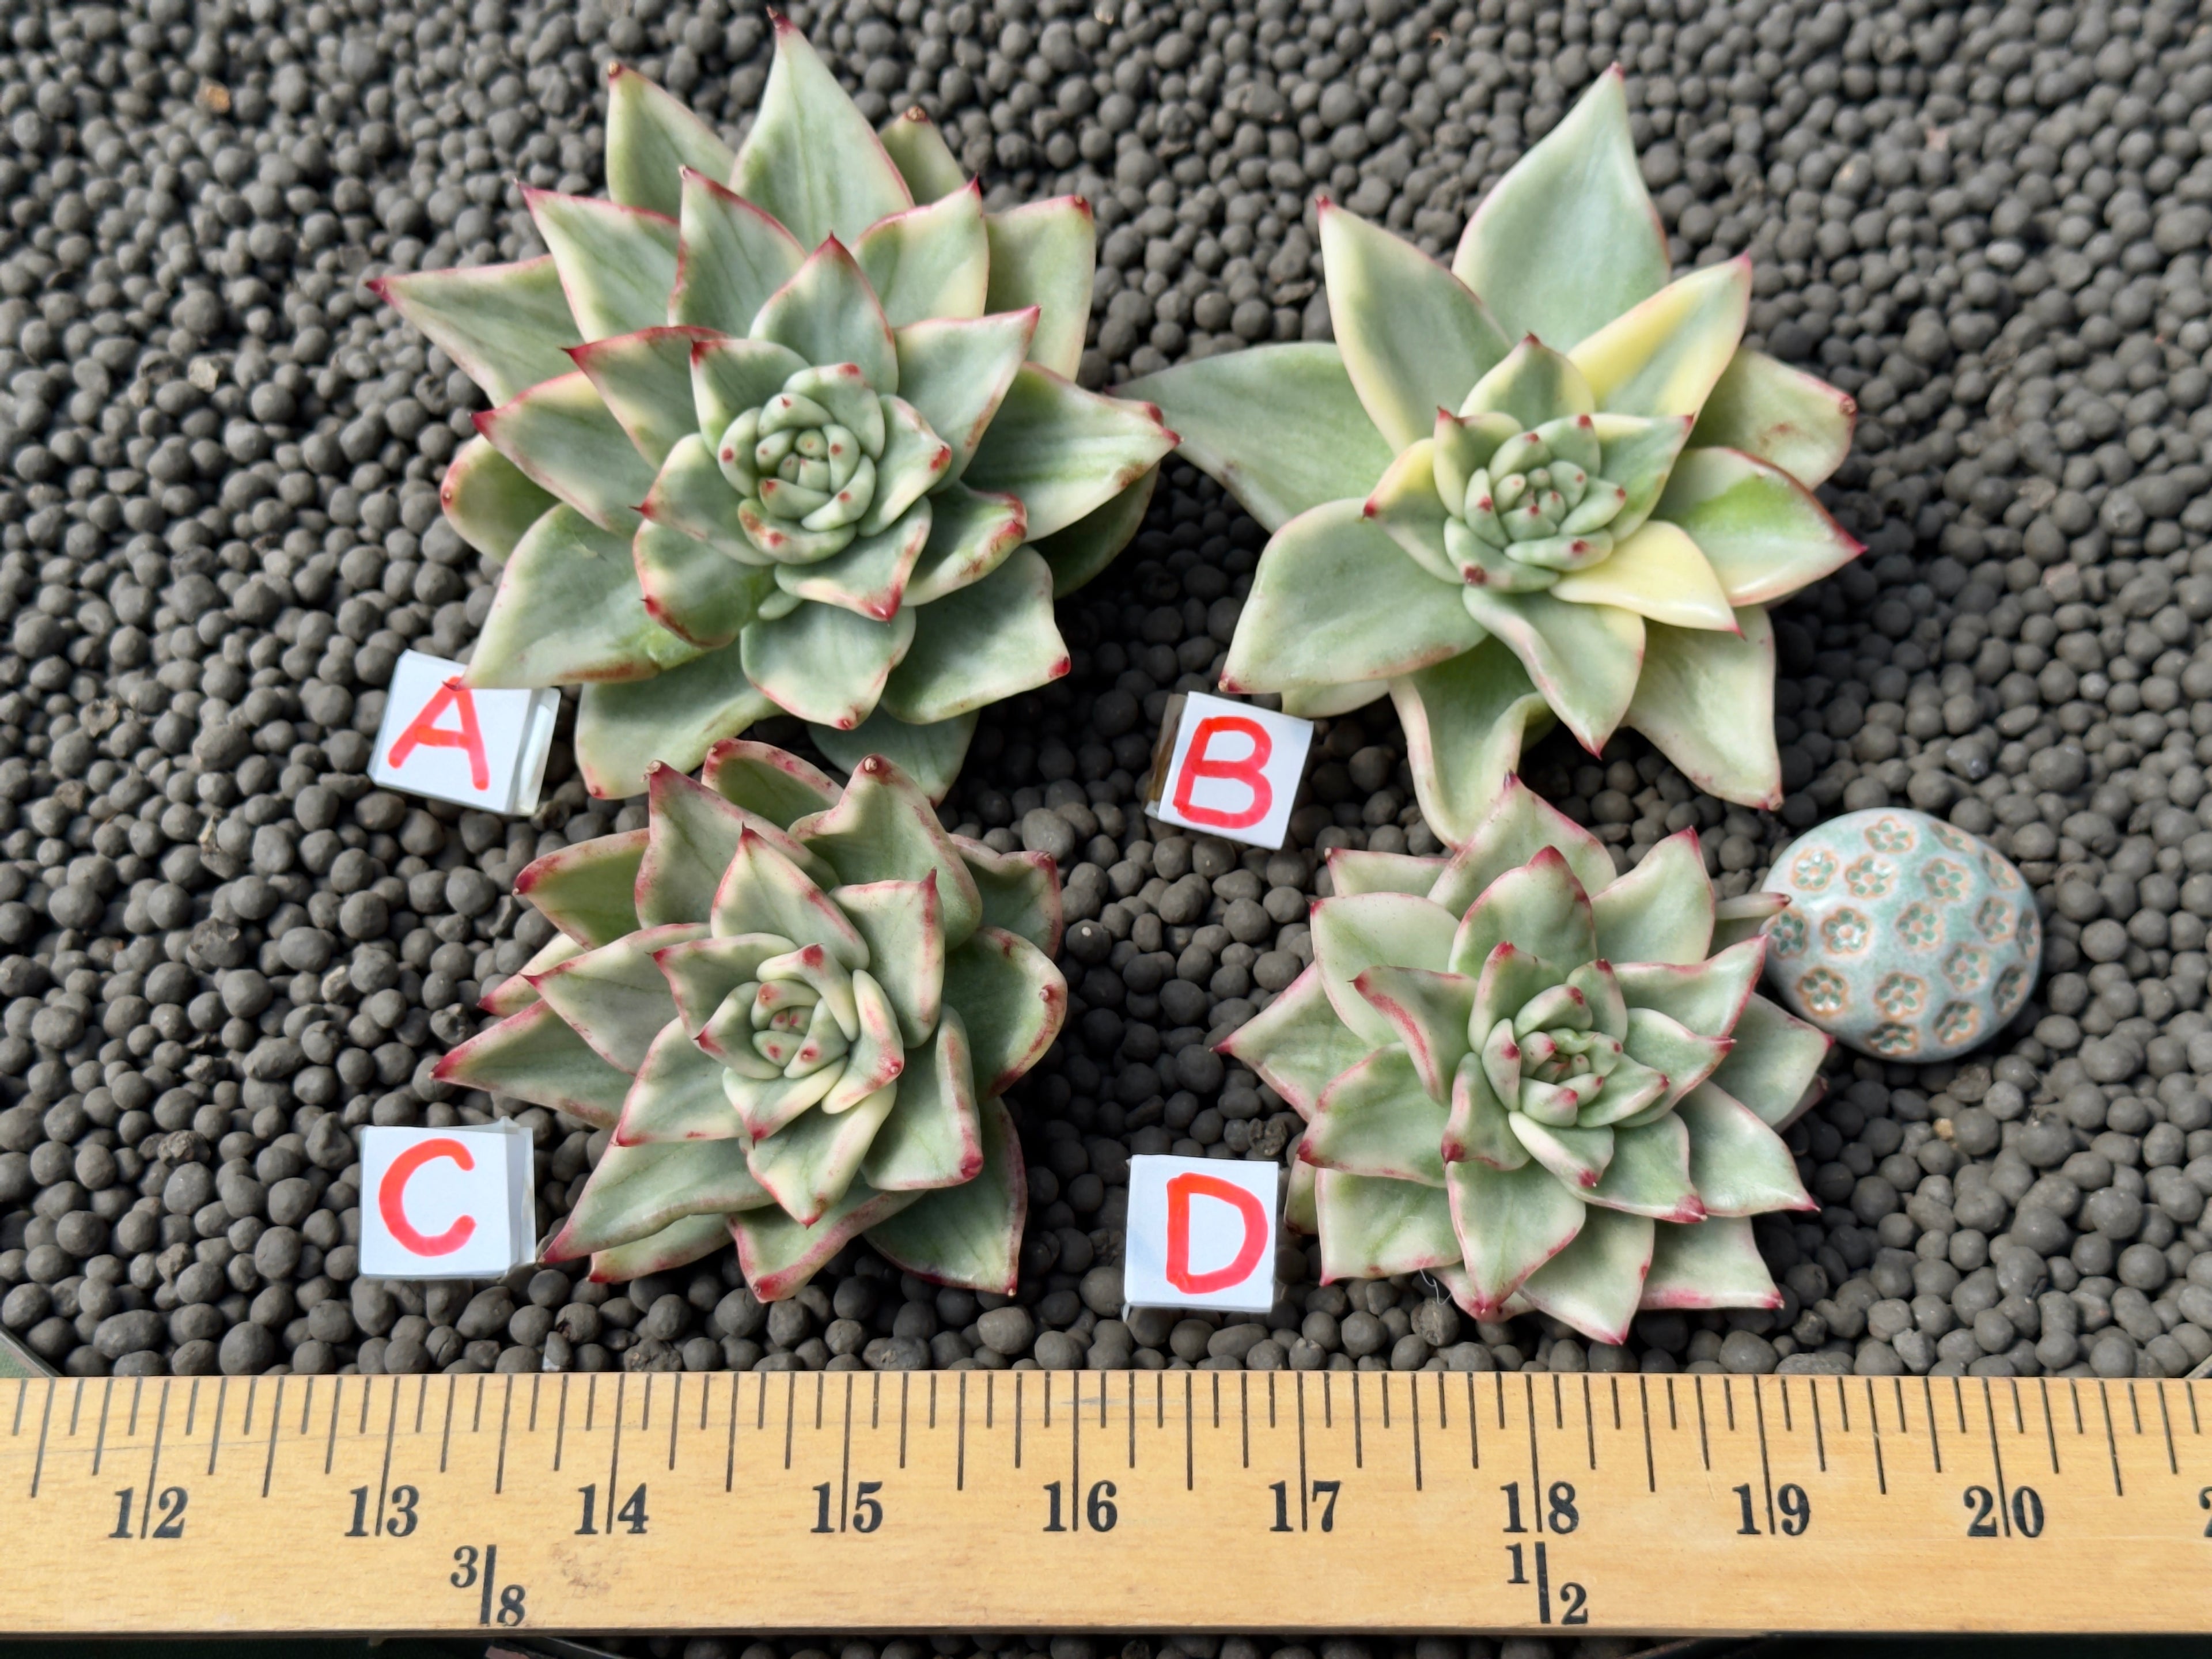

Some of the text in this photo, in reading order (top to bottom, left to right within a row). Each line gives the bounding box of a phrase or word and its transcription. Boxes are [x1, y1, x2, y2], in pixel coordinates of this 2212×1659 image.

[388, 676, 490, 791] A
[1172, 715, 1273, 830] B
[378, 1138, 477, 1257] C
[1165, 1172, 1269, 1294] D
[108, 1486, 189, 1539] 12
[344, 1484, 420, 1537] 13
[574, 1483, 650, 1535] 14
[810, 1481, 884, 1534] 15
[1042, 1480, 1118, 1533] 16
[1268, 1480, 1342, 1533] 17
[1499, 1480, 1580, 1535] 18
[1731, 1482, 1811, 1537] 19
[1963, 1485, 2045, 1539] 20
